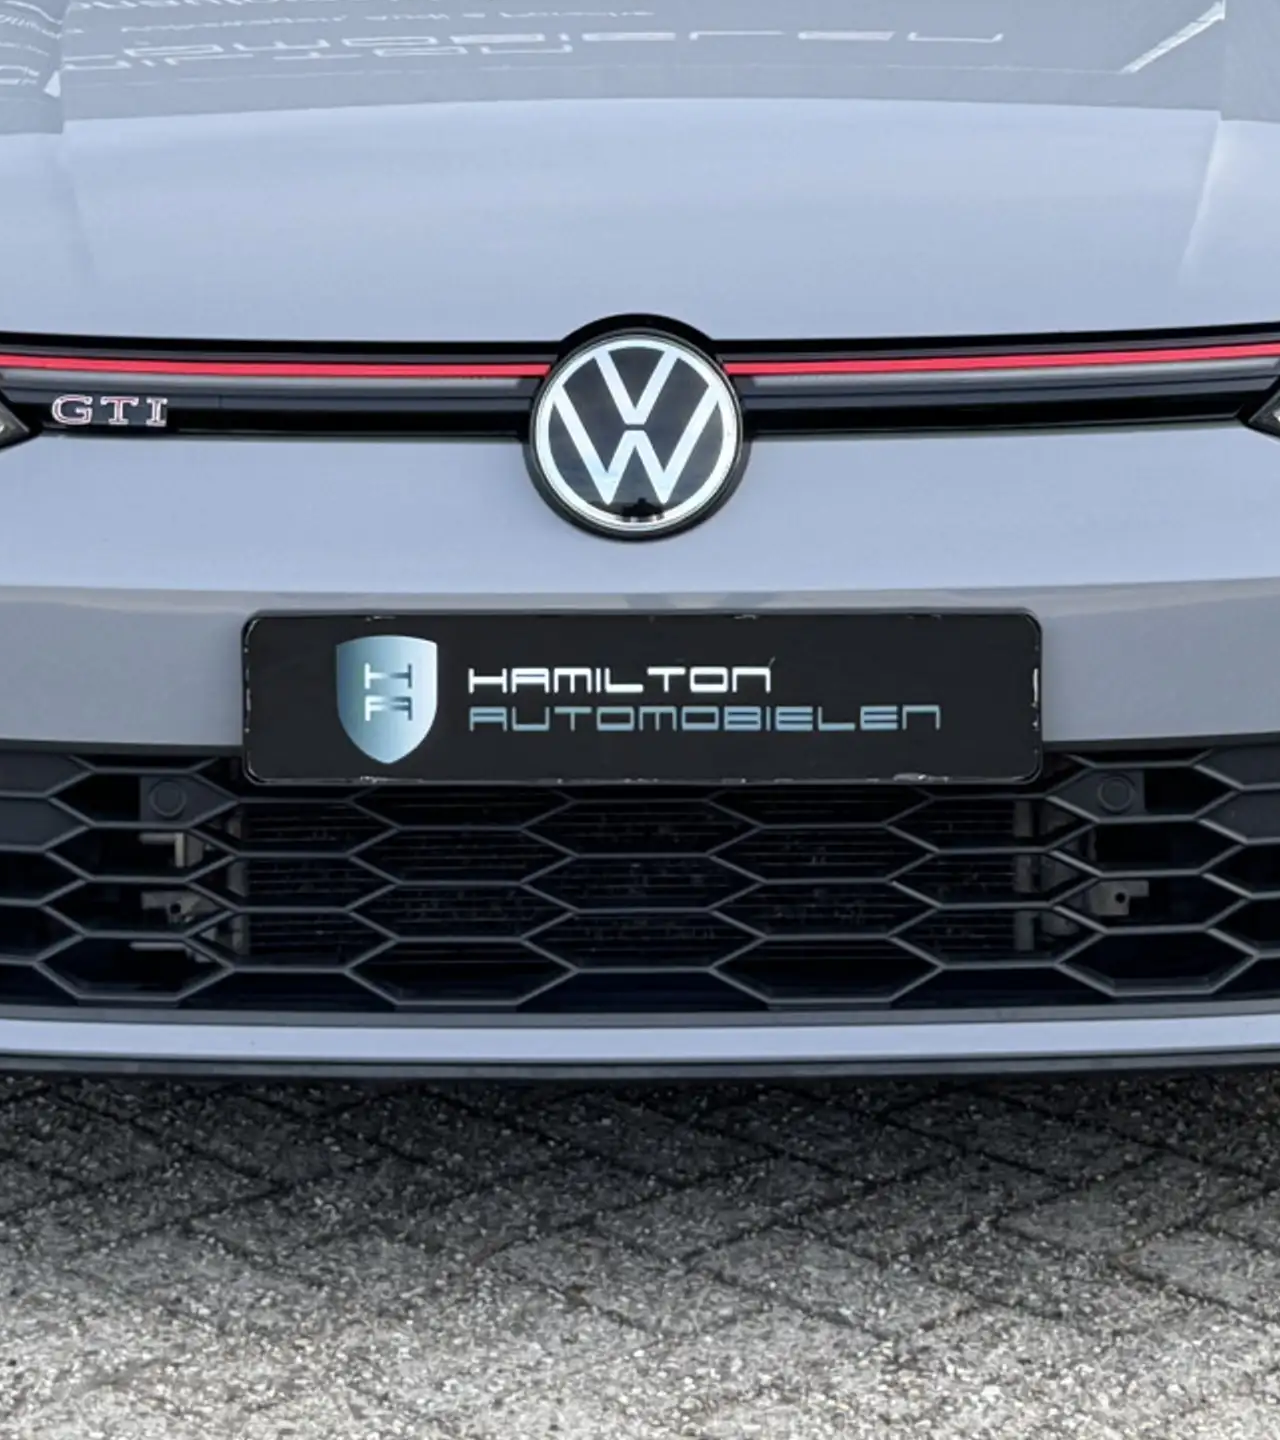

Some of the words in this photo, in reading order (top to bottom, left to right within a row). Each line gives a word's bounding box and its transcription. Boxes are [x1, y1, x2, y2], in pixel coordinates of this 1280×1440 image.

[51, 395, 169, 428] GTI
[468, 665, 772, 694] HAMILTON
[468, 705, 941, 732] AUTOMOBIELEN
